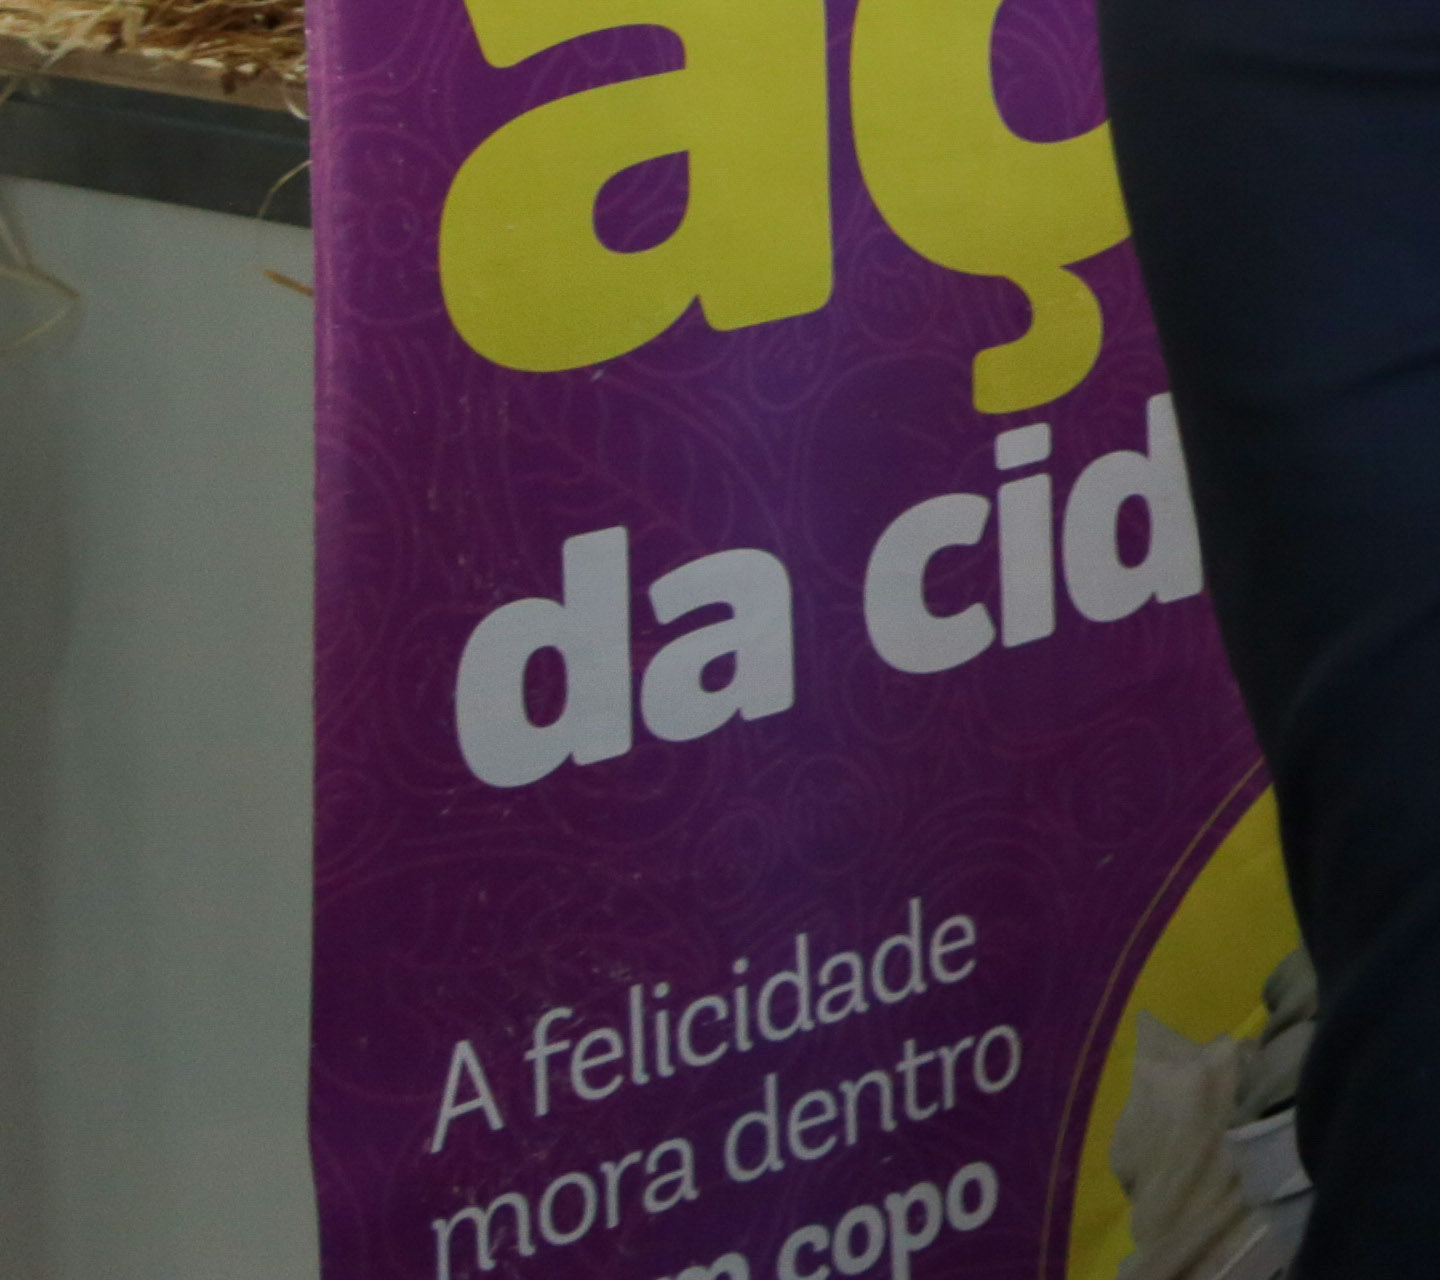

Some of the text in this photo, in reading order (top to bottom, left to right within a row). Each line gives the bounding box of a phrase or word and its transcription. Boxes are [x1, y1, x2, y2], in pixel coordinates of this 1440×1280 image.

[454, 525, 796, 789] da
[429, 897, 978, 1154] A felicidade
[430, 1023, 1023, 1280] mora dentro
[776, 1161, 999, 1280] copo
